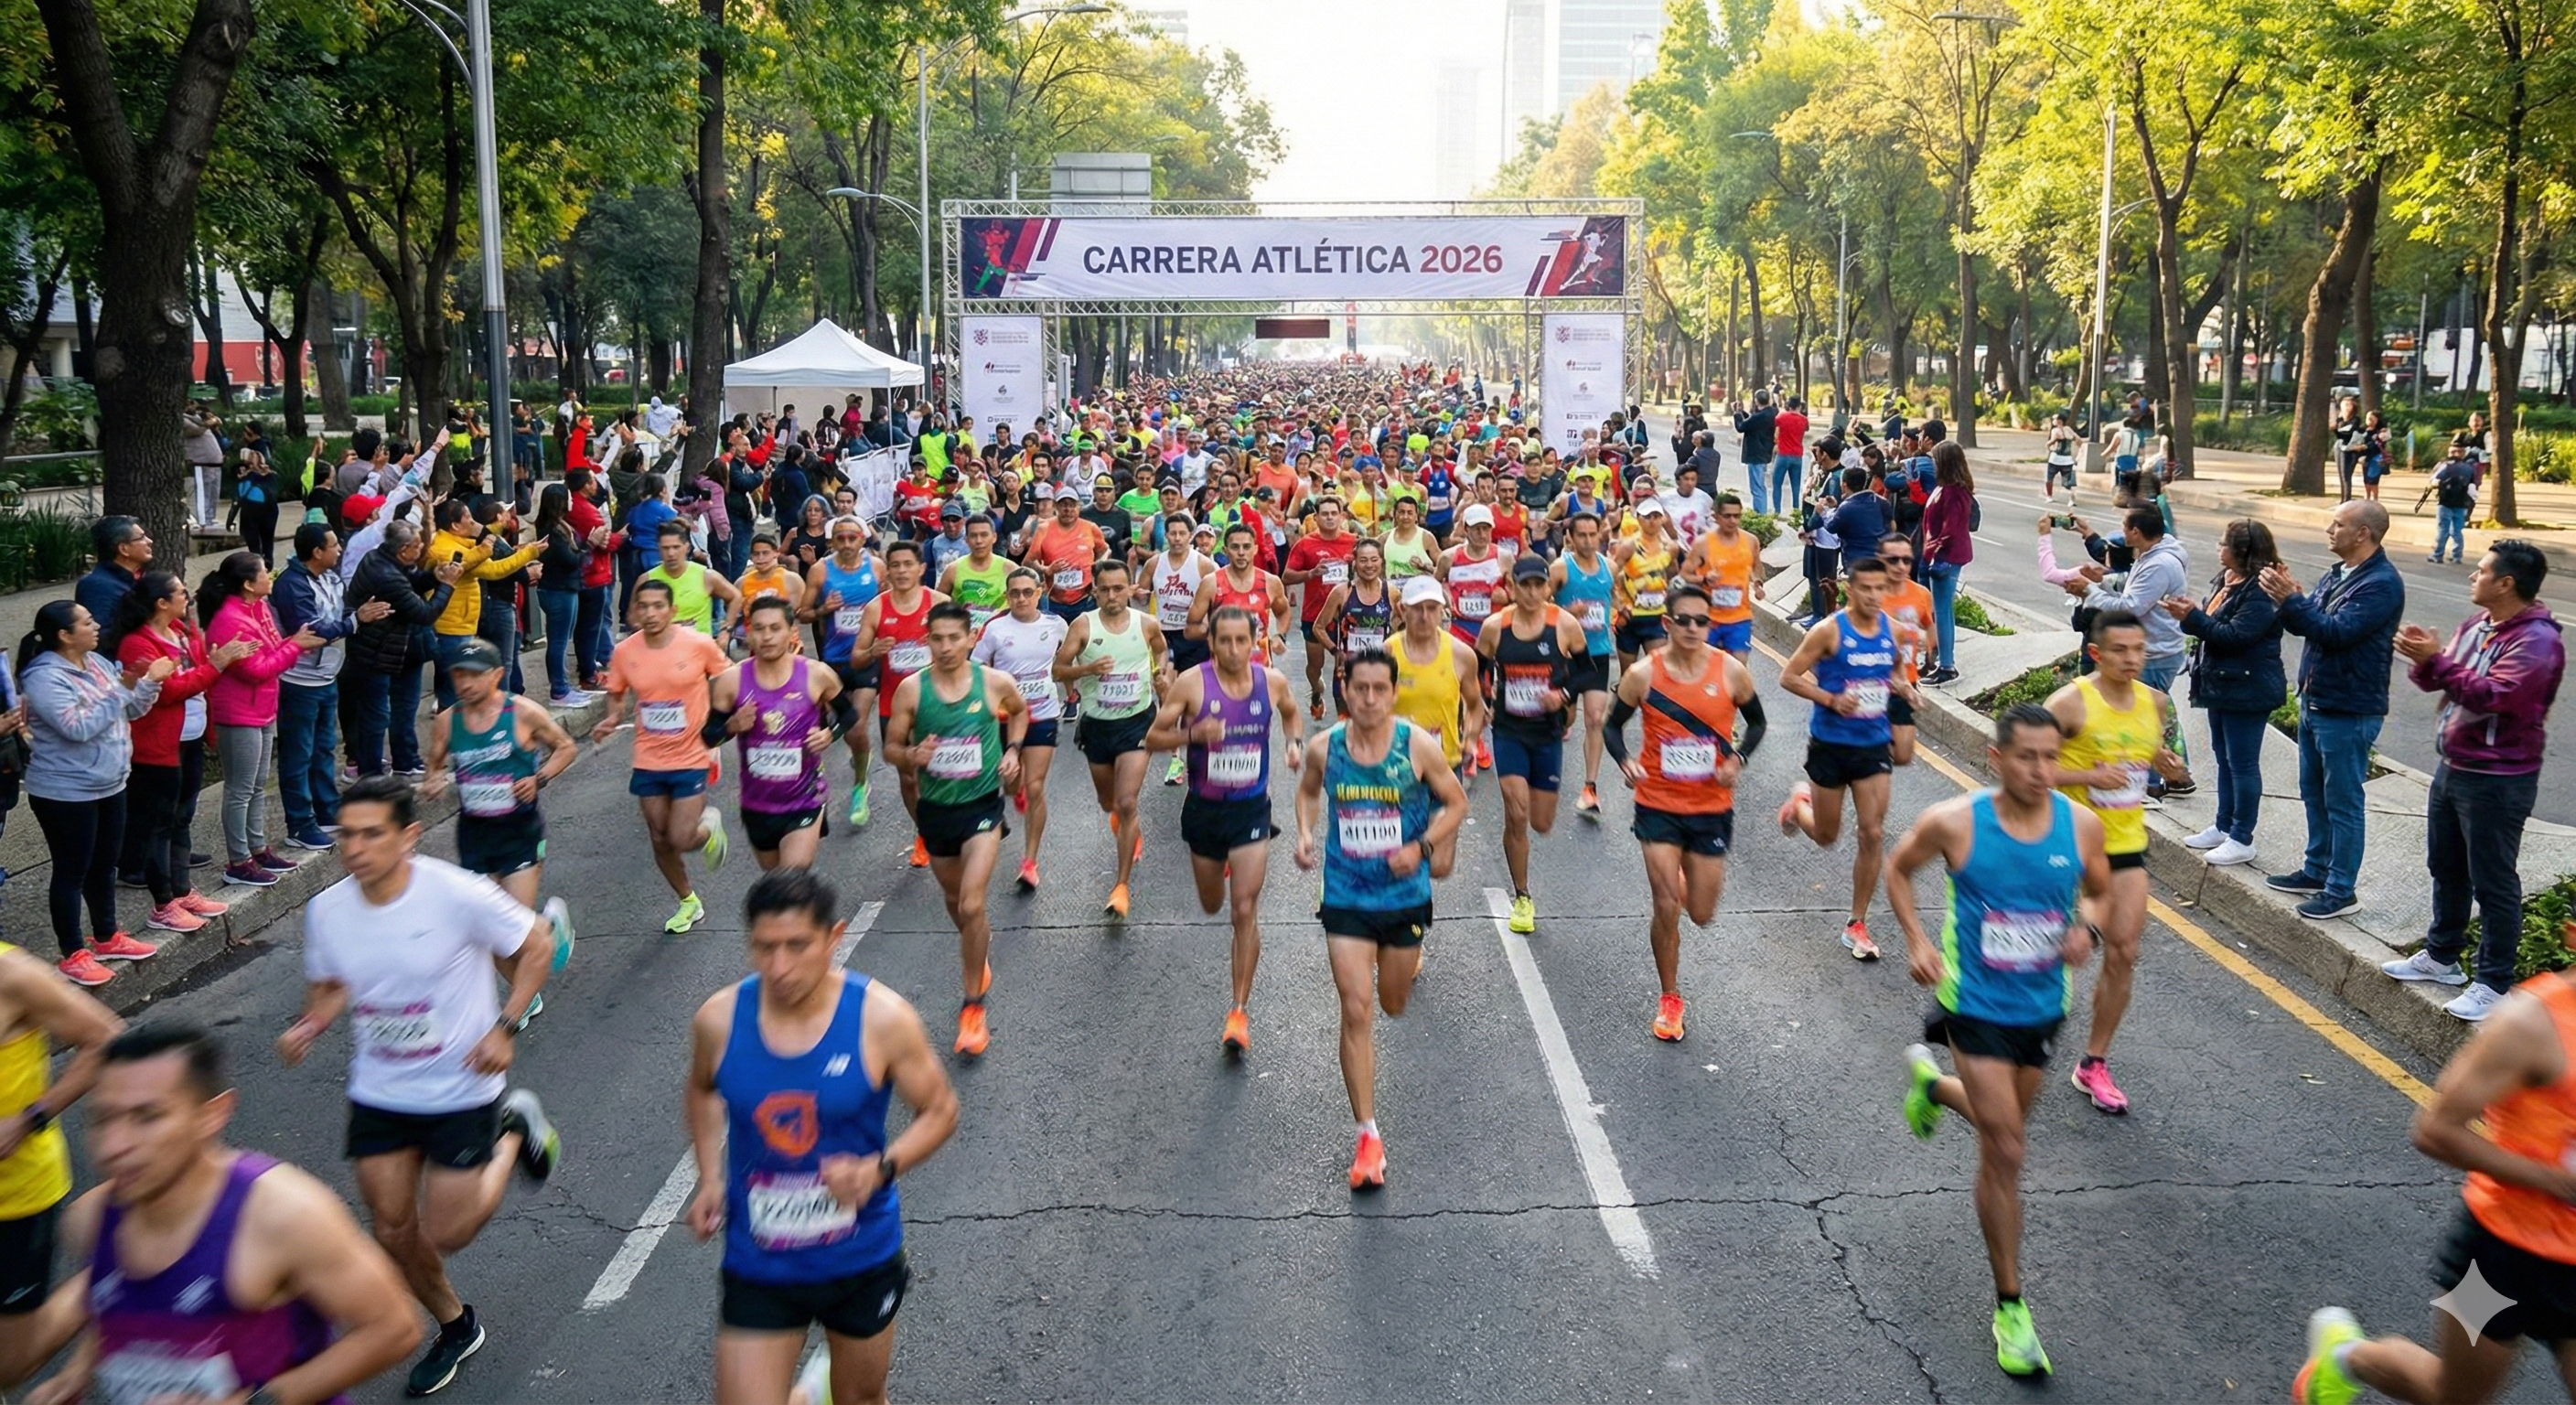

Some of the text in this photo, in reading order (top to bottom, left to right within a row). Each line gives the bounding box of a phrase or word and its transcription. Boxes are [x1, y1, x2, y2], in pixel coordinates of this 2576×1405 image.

[1082, 237, 1504, 274] CARRERA ATLÉTICA 2026
